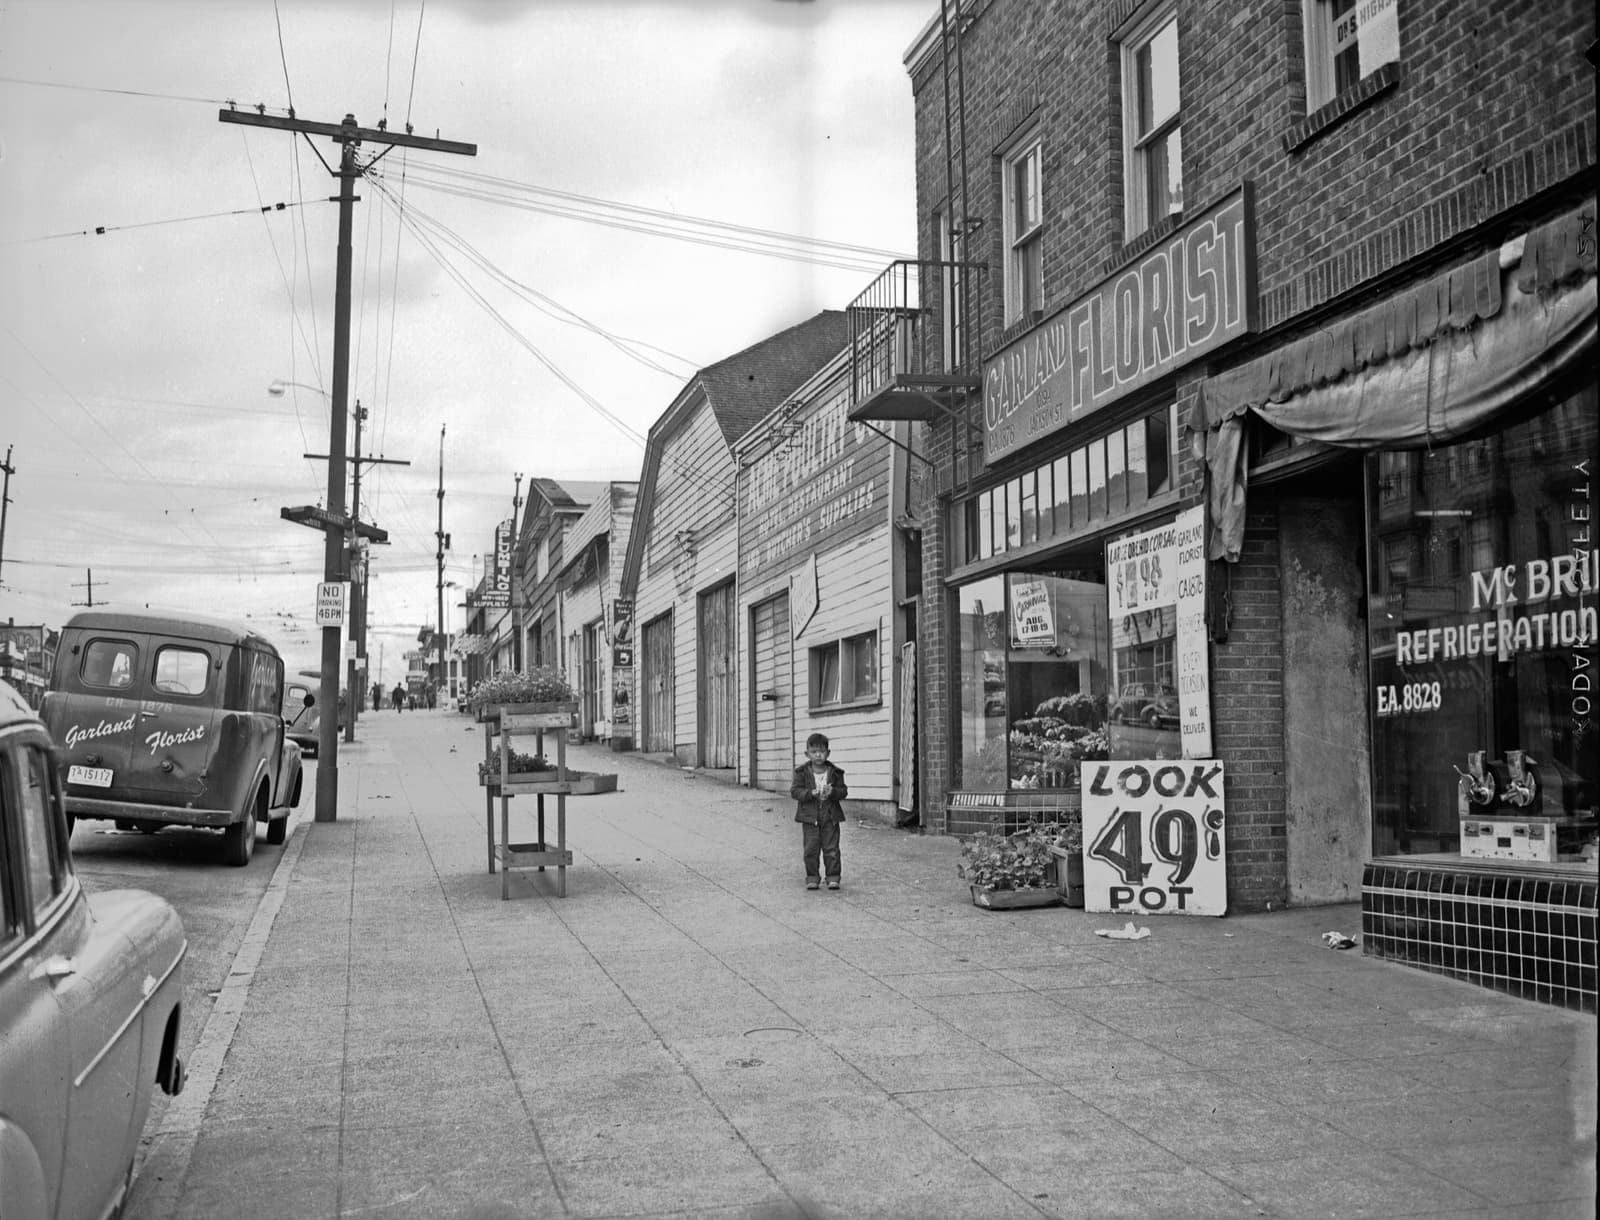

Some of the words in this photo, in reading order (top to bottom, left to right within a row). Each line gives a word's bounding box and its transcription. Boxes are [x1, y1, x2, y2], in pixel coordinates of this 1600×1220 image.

[984, 322, 1066, 432] GARLAND
[1069, 199, 1243, 411] FLORIST
[819, 480, 875, 533] SUPPLIES
[1149, 529, 1176, 552] CORSAG
[1178, 545, 1203, 566] FLORIST
[318, 599, 342, 607] PARKING
[323, 586, 339, 598] NO
[1188, 705, 1199, 718] WE
[64, 713, 137, 749] Garland
[145, 725, 206, 755] Florist
[1183, 722, 1206, 735] DELIVER
[1089, 763, 1223, 799] LOOK
[1109, 886, 1194, 910] POT
